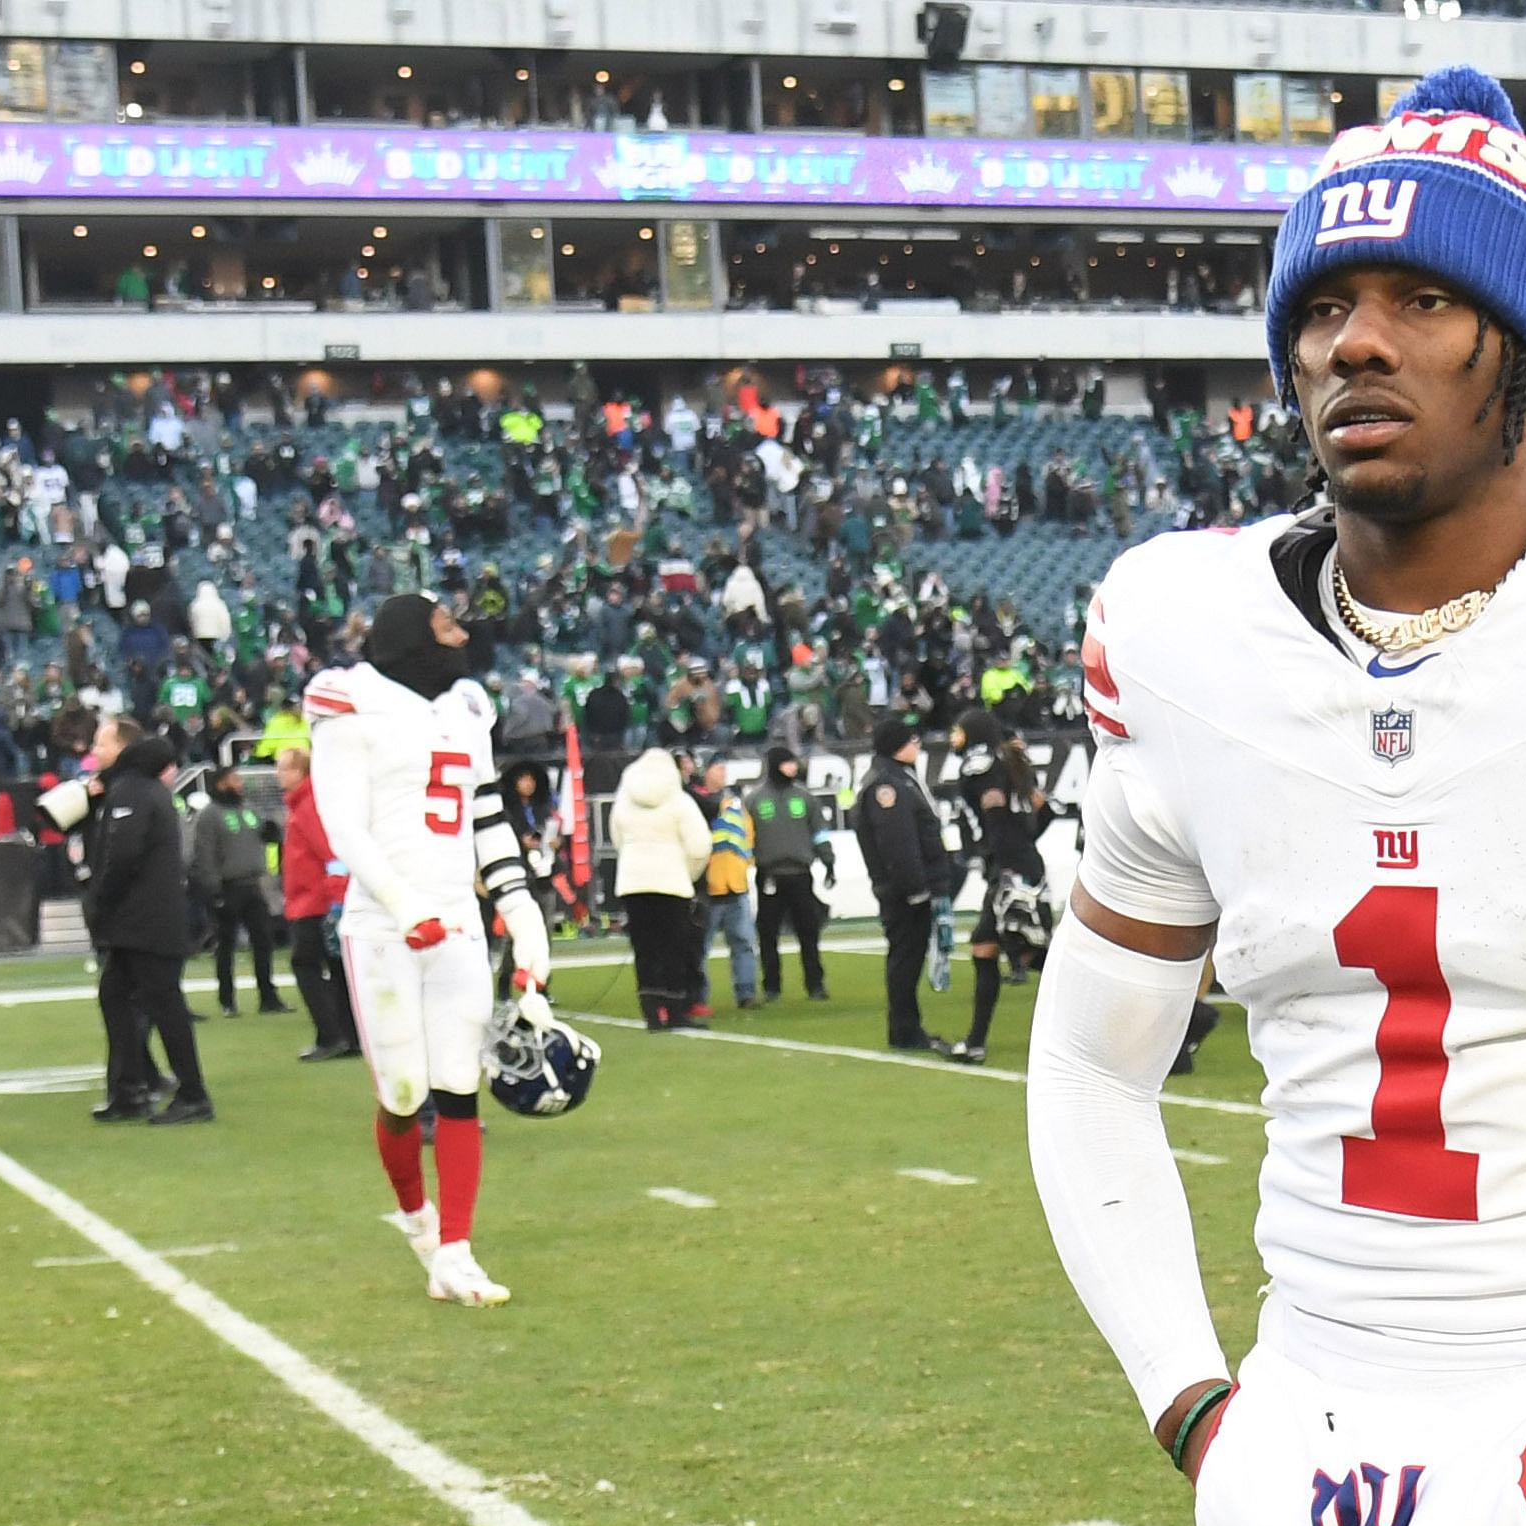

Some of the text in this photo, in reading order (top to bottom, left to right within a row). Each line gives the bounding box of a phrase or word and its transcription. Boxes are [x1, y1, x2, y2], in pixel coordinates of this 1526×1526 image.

[75, 145, 267, 177] BUD LIGHT
[385, 149, 570, 181] BUD LIGHT
[980, 158, 1145, 191] BUD LIGHT
[1376, 731, 1408, 756] NFL
[424, 751, 472, 836] 5
[1333, 885, 1480, 1221] 1
